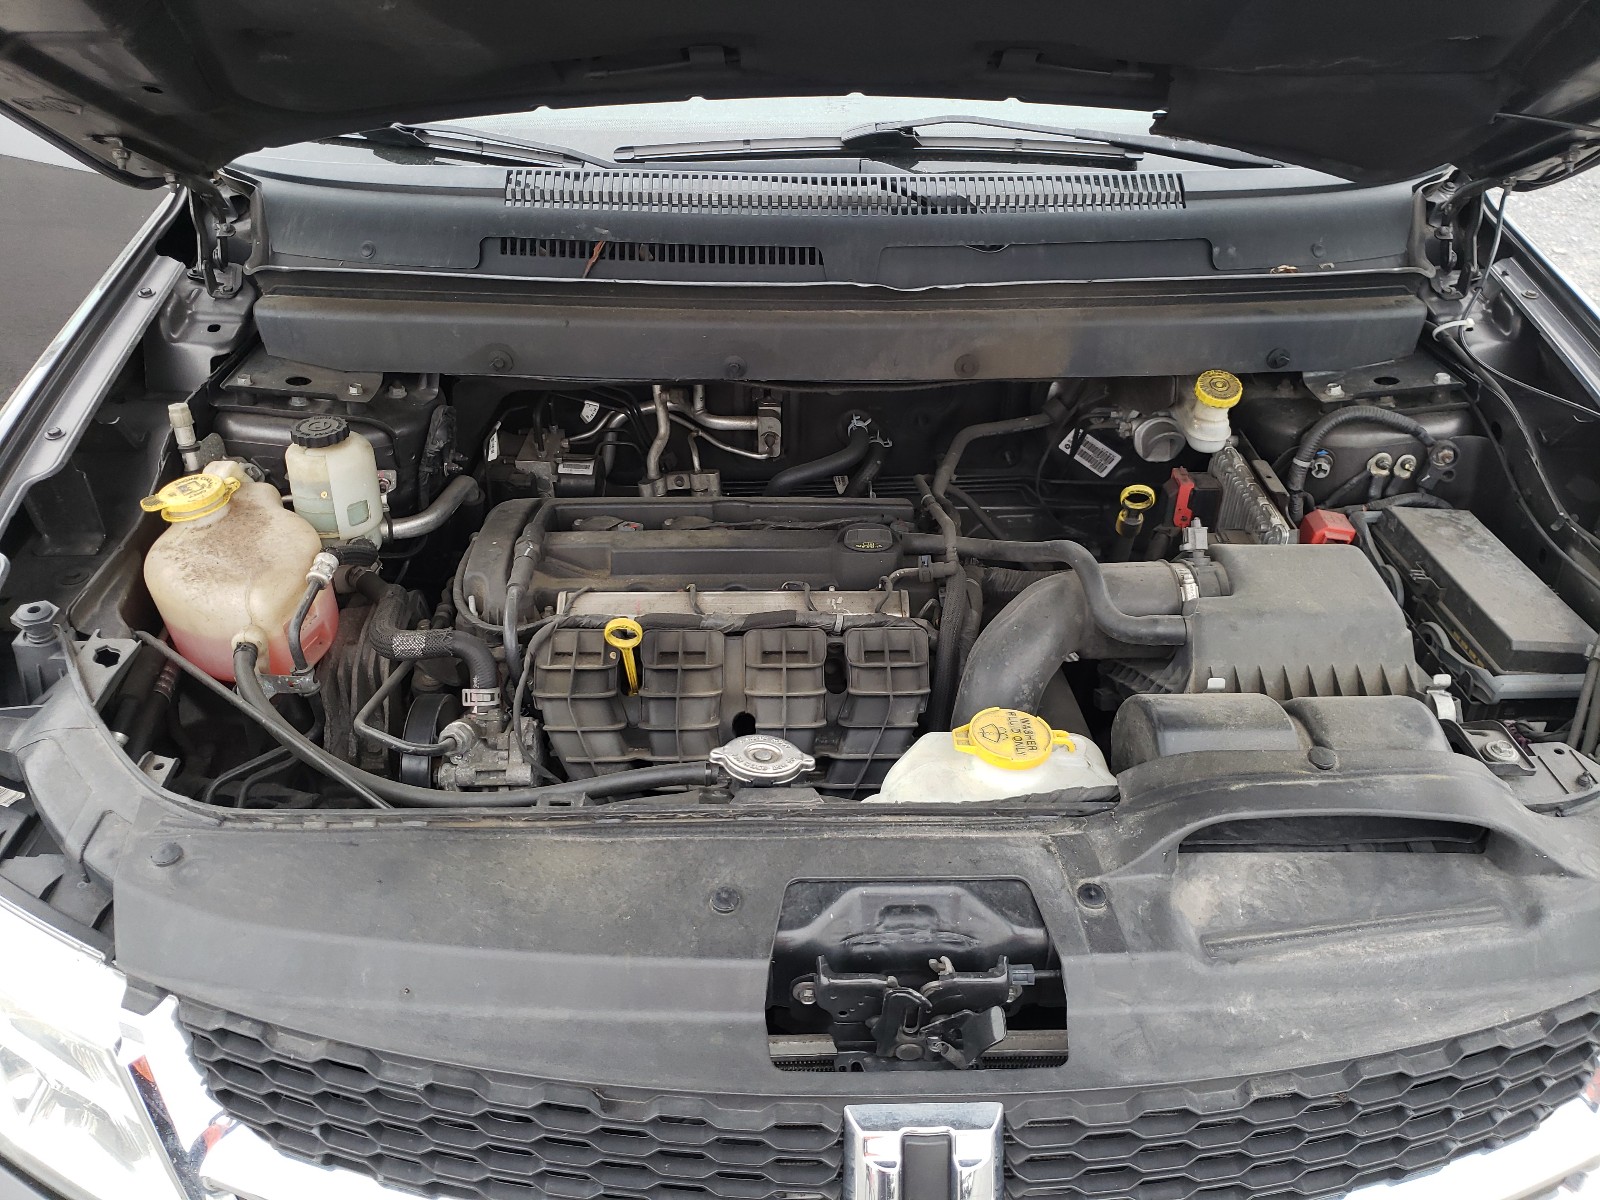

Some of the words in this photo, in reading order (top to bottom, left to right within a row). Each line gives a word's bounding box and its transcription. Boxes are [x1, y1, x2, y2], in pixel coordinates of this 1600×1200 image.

[1008, 711, 1022, 734] FLUD
[1020, 717, 1038, 751] WASHER
[1012, 735, 1027, 756] ONLY
